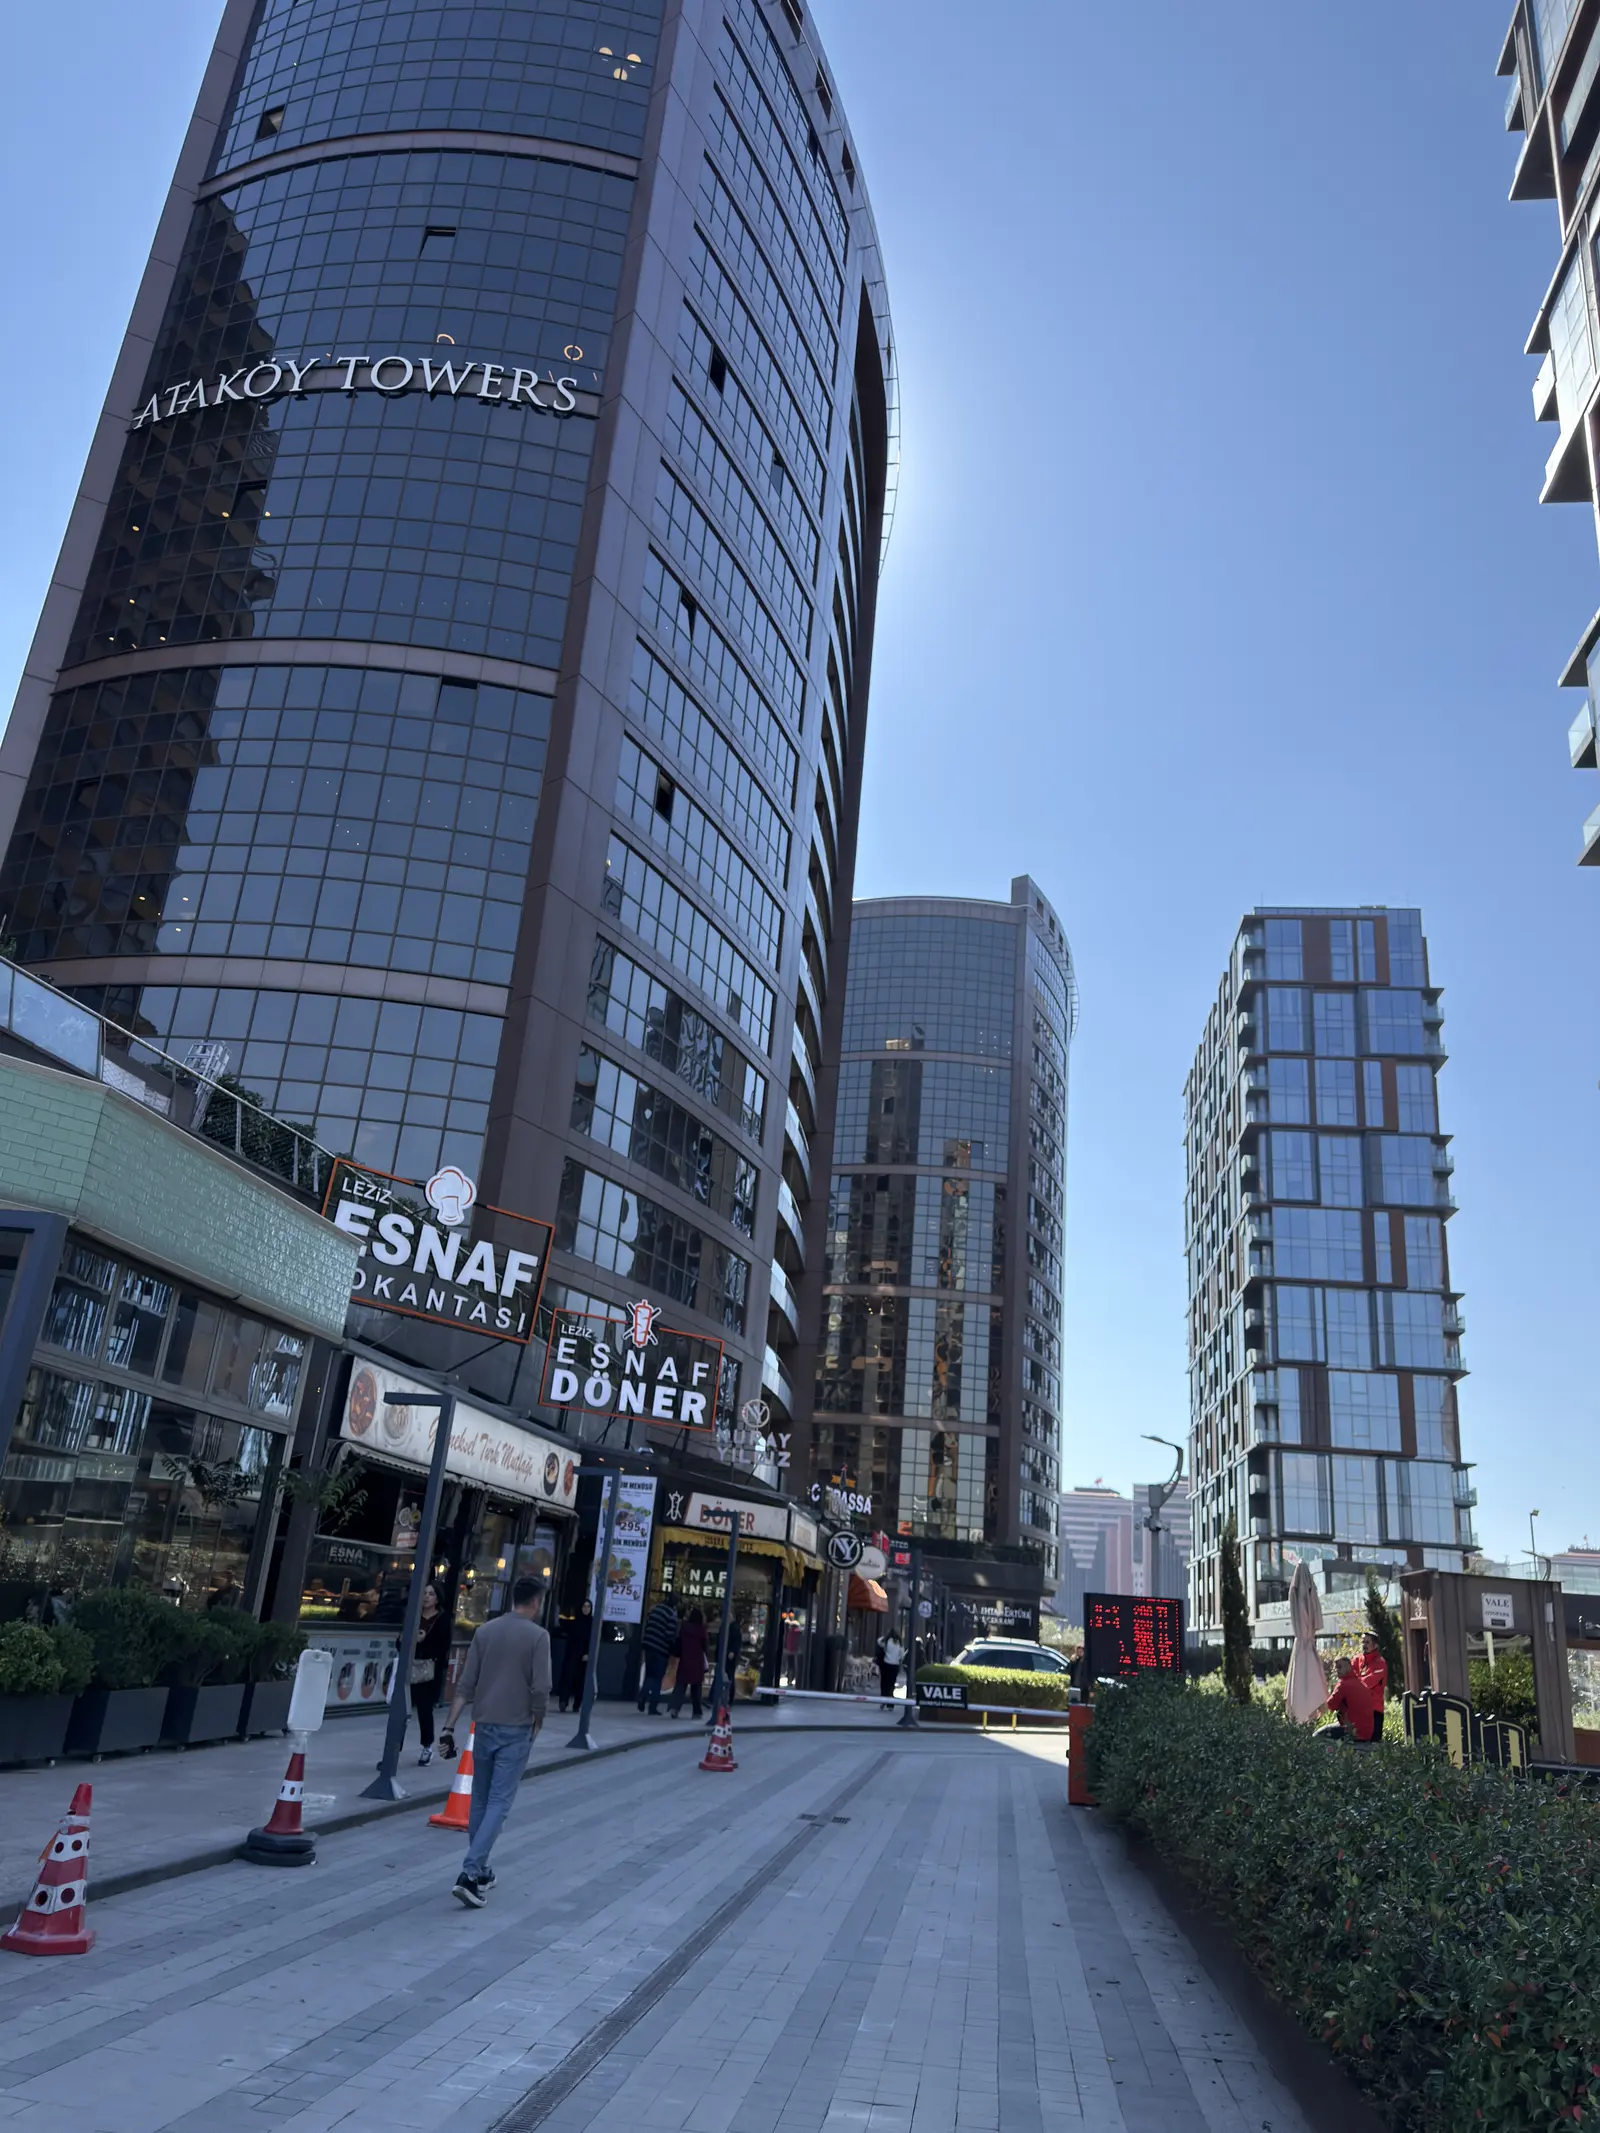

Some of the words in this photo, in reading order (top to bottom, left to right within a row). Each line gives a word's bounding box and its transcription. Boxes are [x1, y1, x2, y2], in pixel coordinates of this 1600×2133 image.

[131, 356, 319, 430] ATAKÖY
[335, 355, 578, 413] TOWERS
[334, 1199, 539, 1298] ESNAF
[351, 1268, 527, 1334] OKANTASI
[556, 1337, 710, 1387] ESNAF
[550, 1368, 707, 1425] DÖNER
[329, 1546, 364, 1559] ESNA
[663, 1566, 728, 1583] ENAF
[1485, 1597, 1510, 1608] VALE
[922, 1685, 962, 1700] VALE
